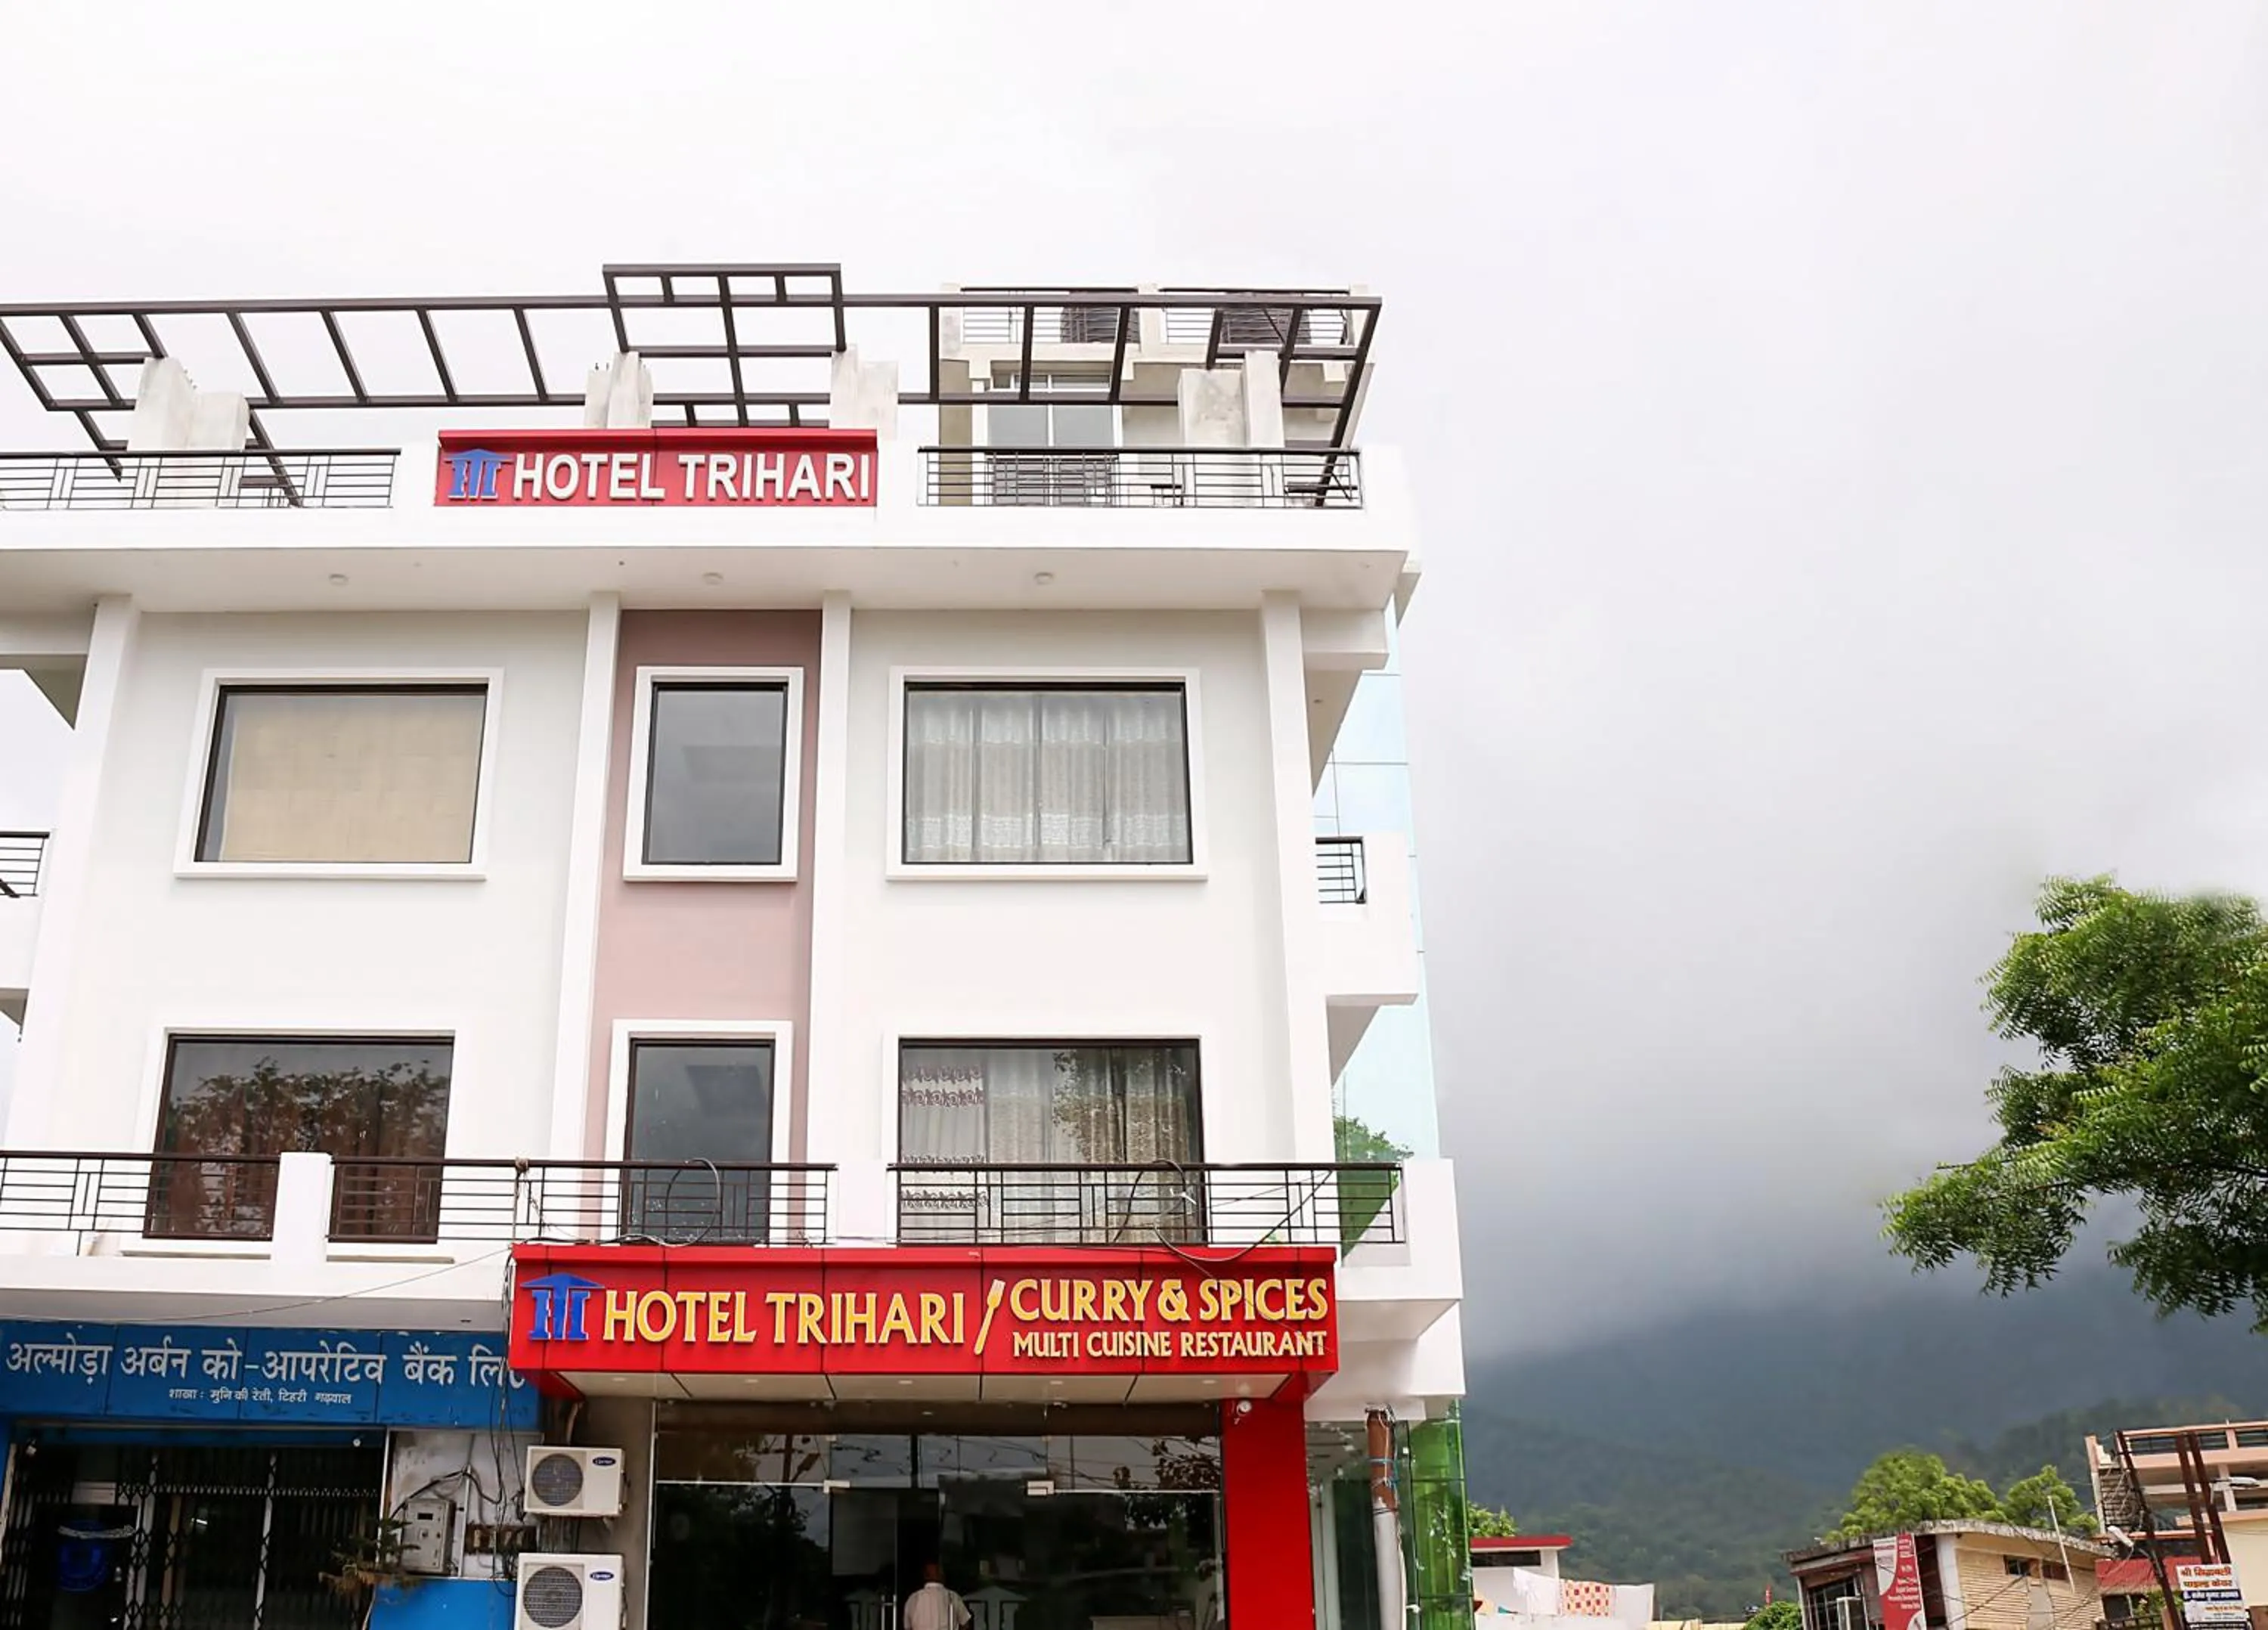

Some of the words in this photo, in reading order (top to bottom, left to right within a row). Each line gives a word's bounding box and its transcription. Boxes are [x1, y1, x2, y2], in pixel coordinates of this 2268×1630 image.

[513, 453, 665, 500] HOTEL
[678, 453, 869, 500] TRIHARI
[603, 1290, 757, 1343] HOTEL
[766, 1291, 965, 1344] TRIHARI
[1010, 1278, 1153, 1322] CURRY
[1157, 1278, 1190, 1322] &
[1199, 1278, 1328, 1322] SPICES
[6, 1332, 113, 1384] अल्मोड़ा
[121, 1335, 191, 1381] अर्बन
[402, 1342, 457, 1387] बैंक
[1012, 1331, 1080, 1358] MULTI
[1086, 1331, 1172, 1358] CUISINE
[1181, 1330, 1328, 1358] RESTAURANT
[234, 1387, 249, 1402] की
[278, 1387, 307, 1402] टिहरी
